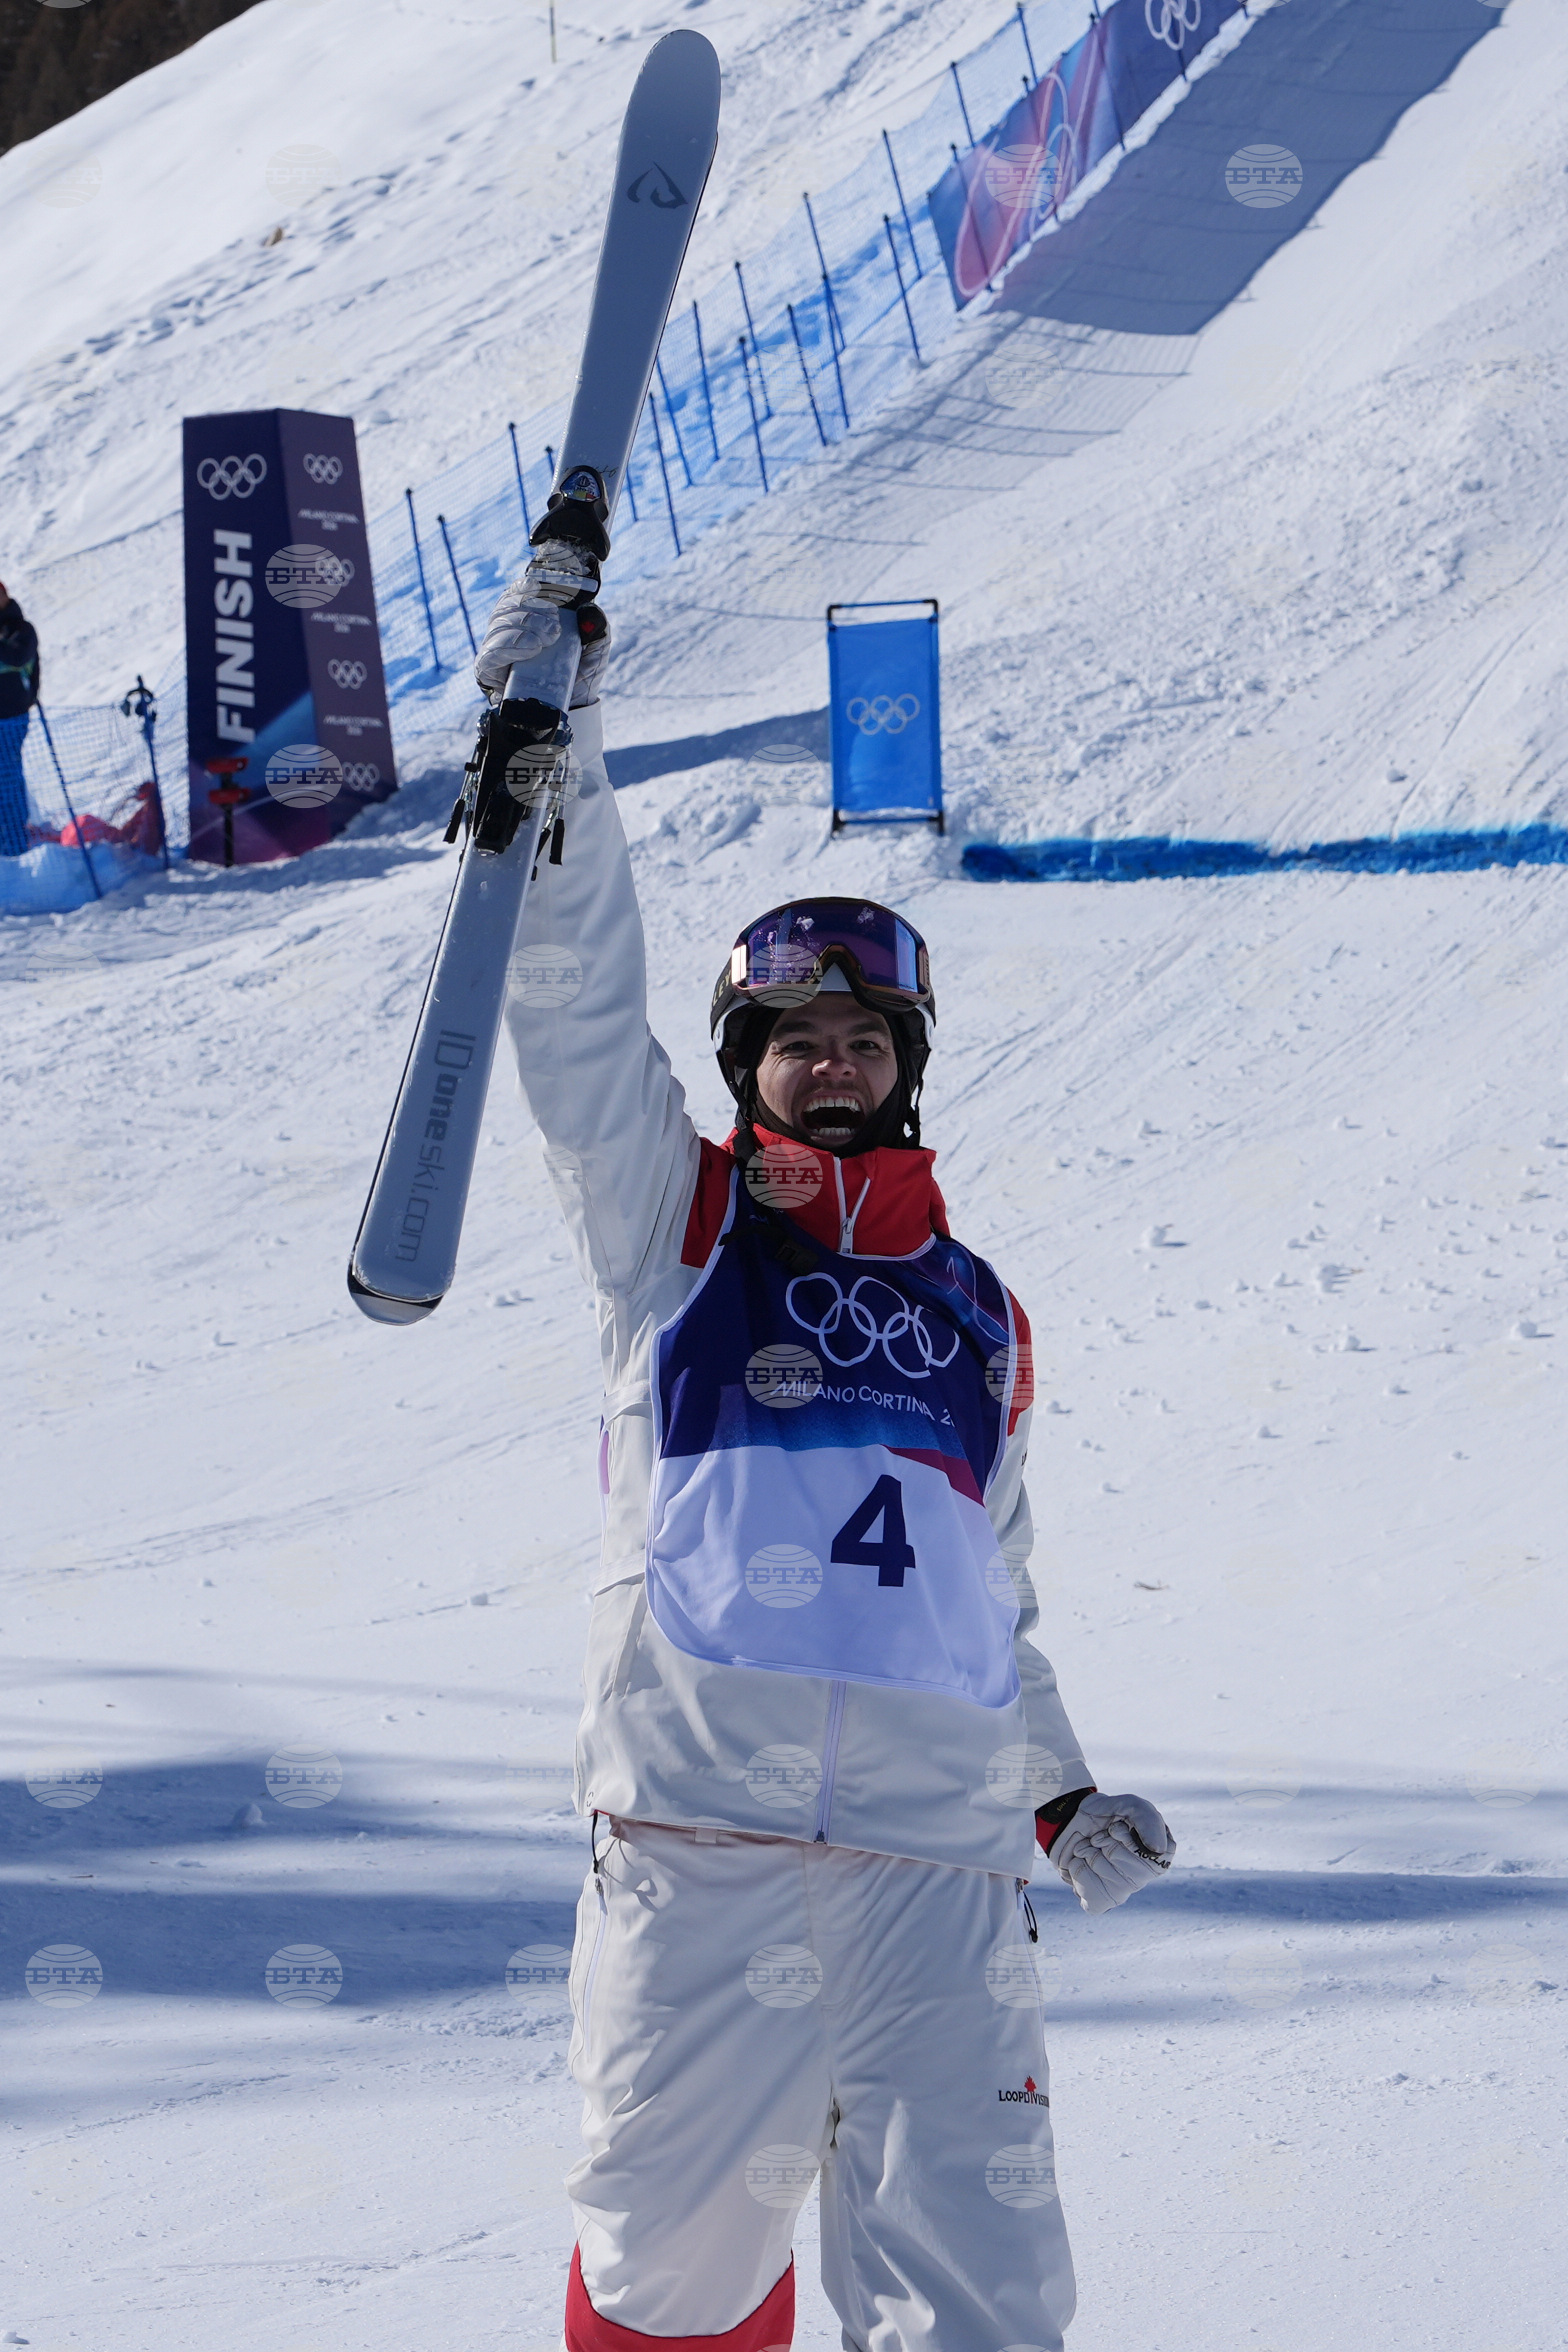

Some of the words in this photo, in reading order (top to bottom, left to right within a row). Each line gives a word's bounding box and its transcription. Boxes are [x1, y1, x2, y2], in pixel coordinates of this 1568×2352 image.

[213, 529, 255, 744] FINISH
[770, 1381, 855, 1403] MILANO
[859, 1385, 935, 1421] CORTINA
[831, 1474, 916, 1587] 4
